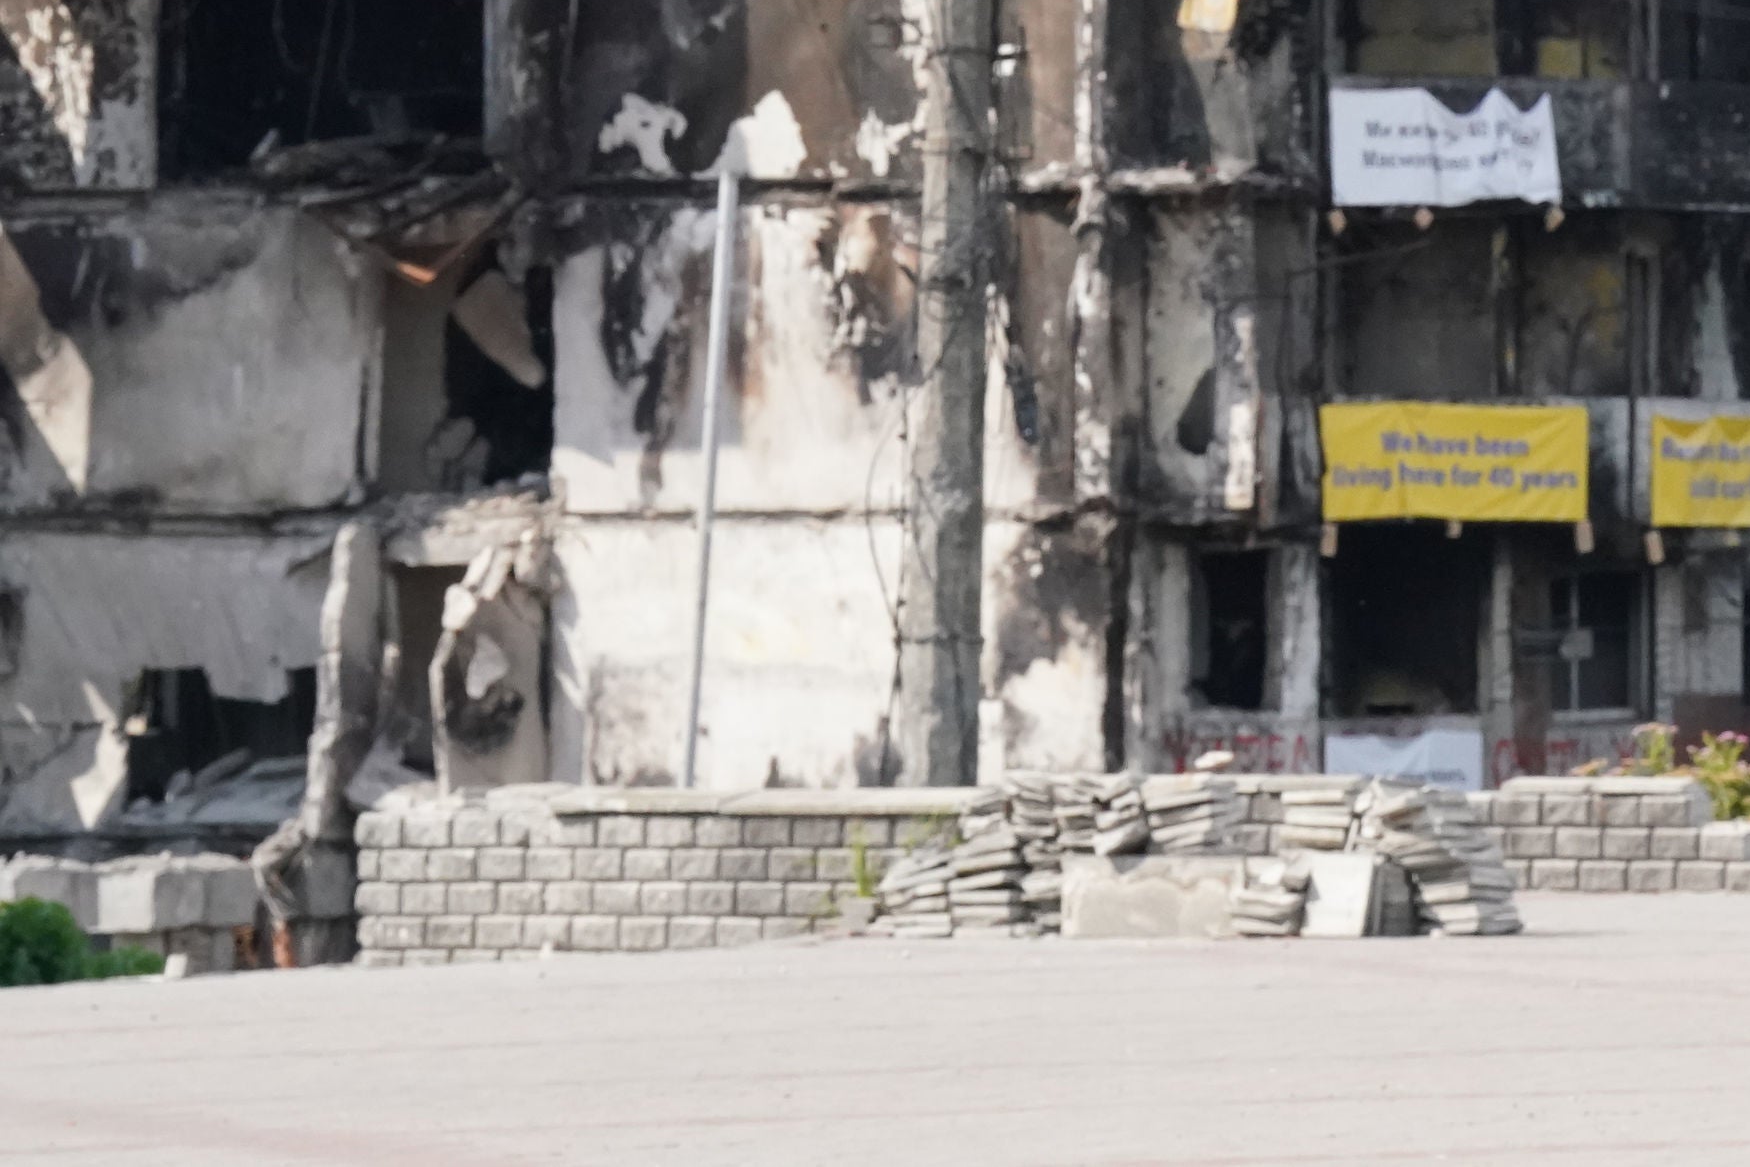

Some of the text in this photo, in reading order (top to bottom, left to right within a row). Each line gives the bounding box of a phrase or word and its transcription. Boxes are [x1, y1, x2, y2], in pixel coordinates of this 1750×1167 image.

[1381, 431, 1529, 456] We have been
[1399, 462, 1446, 485] here
[1451, 463, 1481, 485] for
[1488, 467, 1514, 486] 40
[1521, 471, 1578, 493] years
